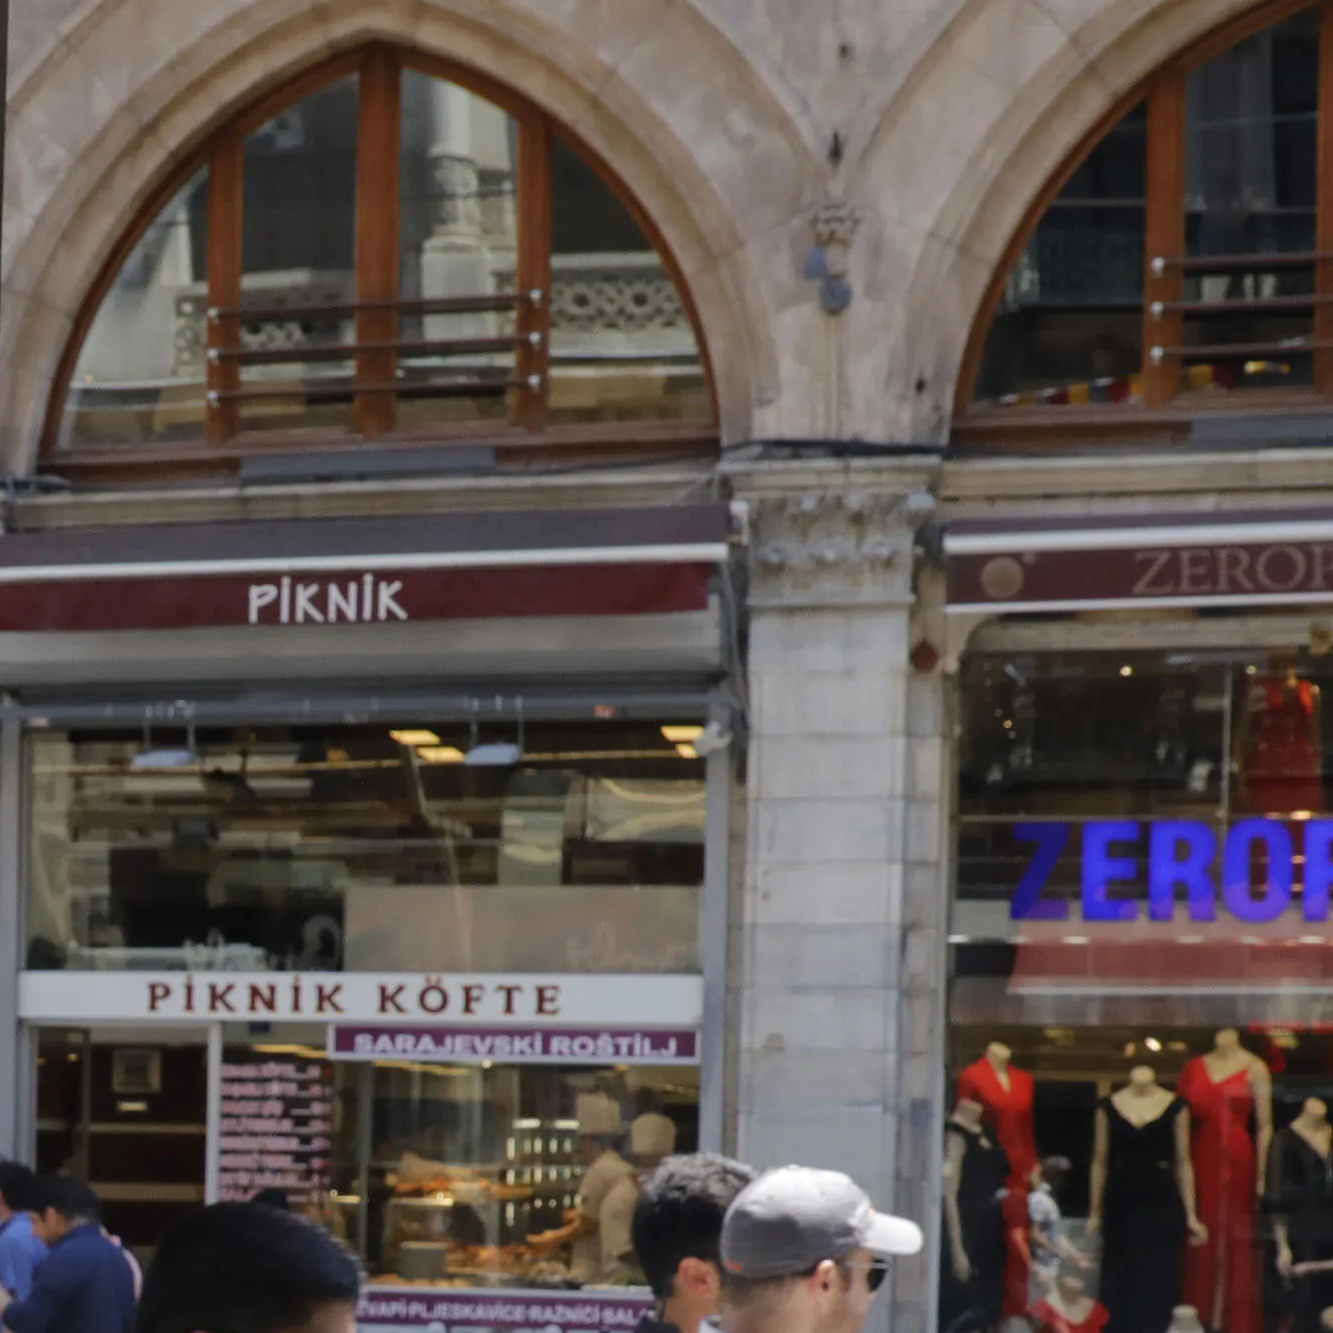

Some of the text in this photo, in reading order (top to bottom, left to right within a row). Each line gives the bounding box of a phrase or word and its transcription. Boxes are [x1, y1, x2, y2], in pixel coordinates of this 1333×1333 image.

[247, 572, 409, 625] PİKNİK
[146, 974, 562, 1014] PİKNİK KÖFTE
